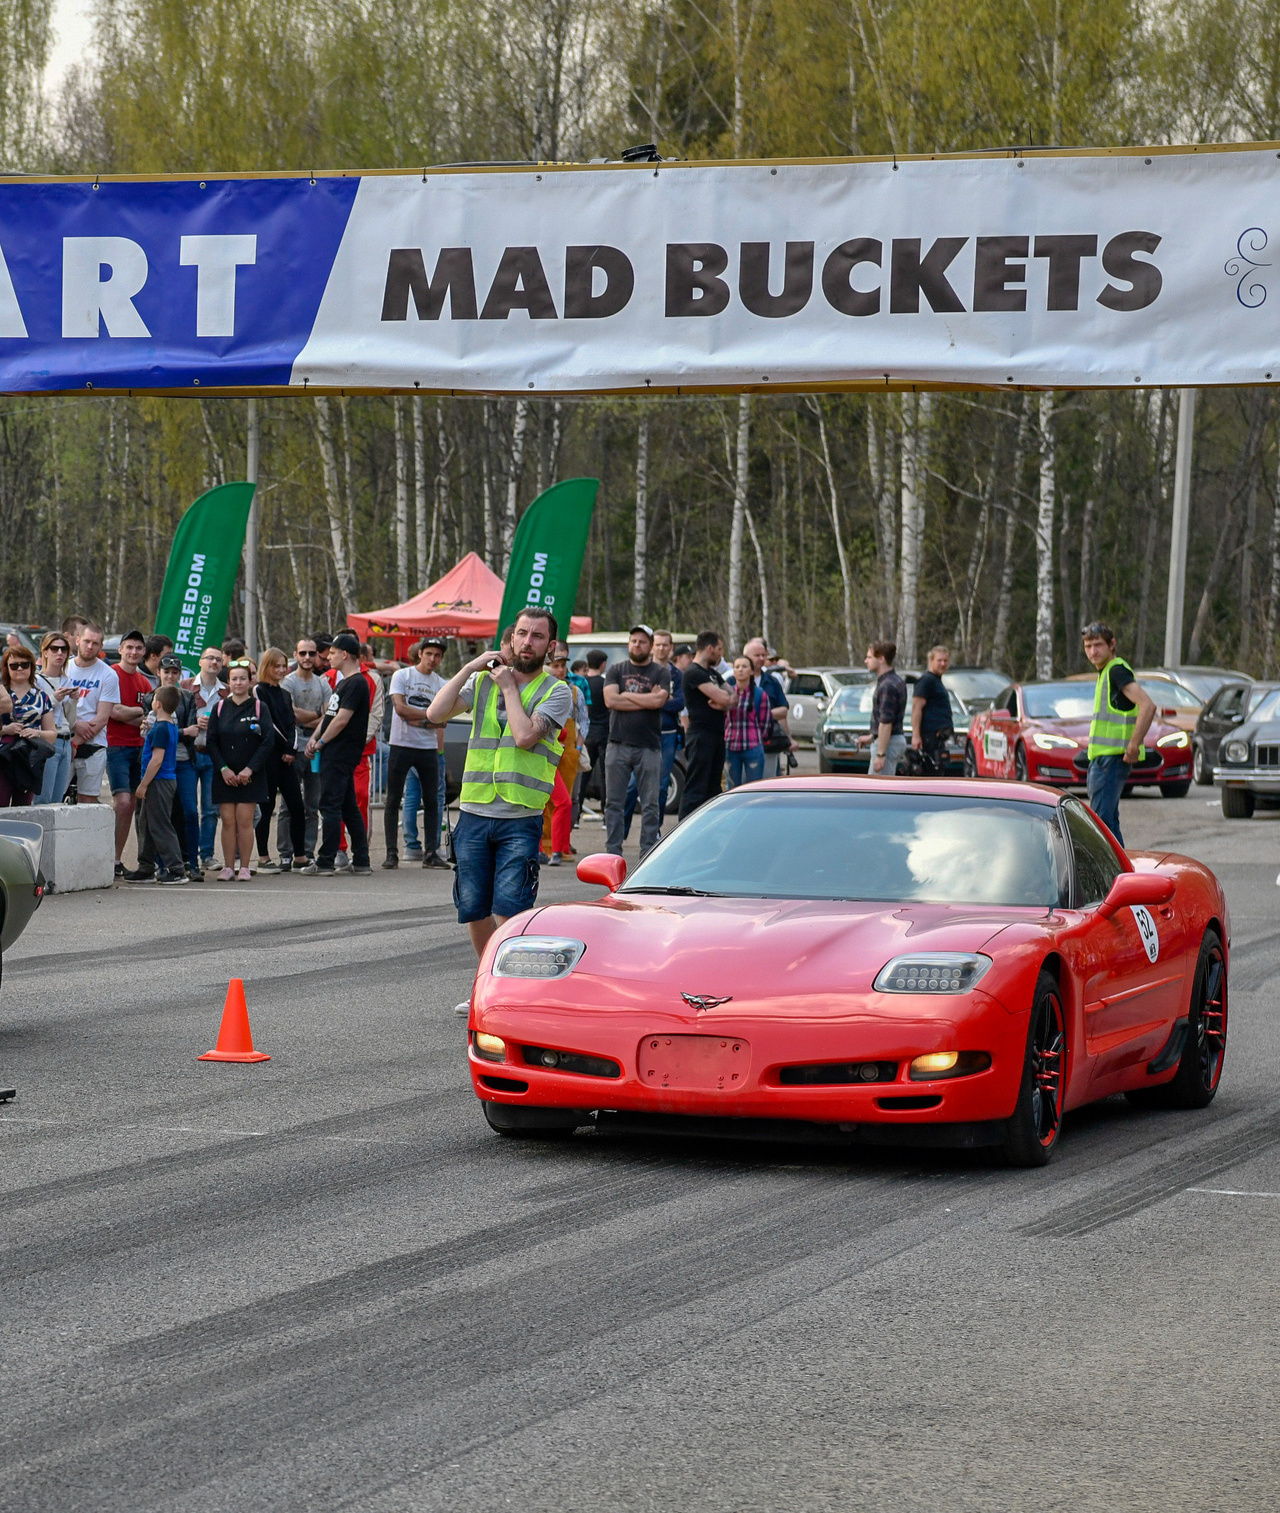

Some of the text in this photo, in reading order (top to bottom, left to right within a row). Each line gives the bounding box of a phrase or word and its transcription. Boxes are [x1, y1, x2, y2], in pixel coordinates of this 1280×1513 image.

[380, 230, 1164, 322] MAD BUCKETS
[174, 553, 206, 655] FREEDOM
[188, 594, 212, 657] finance
[1135, 908, 1154, 940] 52
